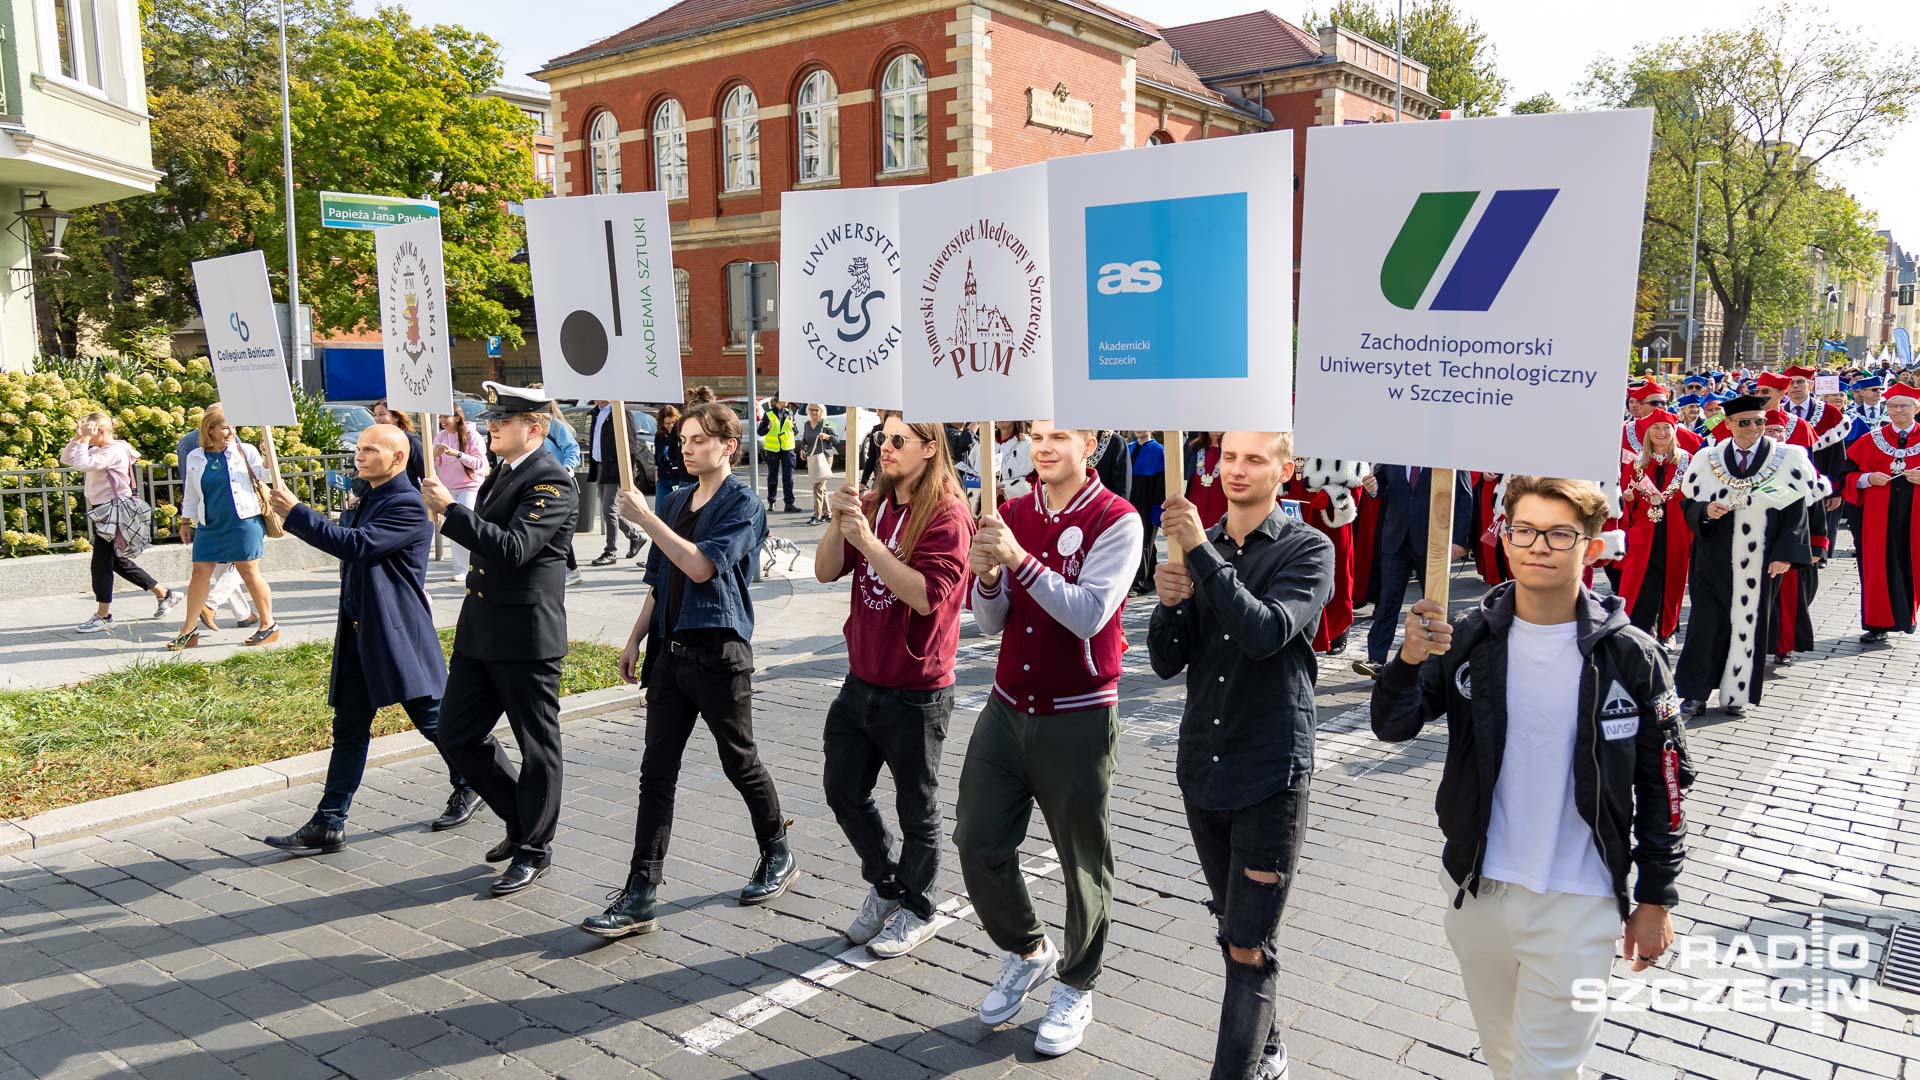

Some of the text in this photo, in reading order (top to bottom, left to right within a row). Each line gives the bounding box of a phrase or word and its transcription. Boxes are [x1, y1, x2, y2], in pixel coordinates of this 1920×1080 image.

[328, 207, 369, 220] Papieża
[371, 211, 395, 221] Jana
[390, 241, 436, 337] POLITECHNIKA MORSKA
[920, 219, 1045, 368] Pomorski Uniwersytet Medyczny w Szczecinie
[1097, 260, 1163, 295] as
[633, 218, 658, 378] AKADEMIA SZTUKI
[217, 346, 275, 362] Collegium Balticum
[802, 321, 902, 374] SZCZECIŃSKI
[949, 341, 1015, 379] PUM
[1099, 340, 1150, 351] Akademicki
[1099, 354, 1136, 365] Szczecin
[1360, 333, 1553, 357] Zachodniopomorski
[400, 364, 434, 396] SZCZECIN
[1319, 355, 1597, 388] Uniwersytet Technologiczny
[1388, 384, 1513, 406] w Szczecinie
[1606, 722, 1636, 735] NASA
